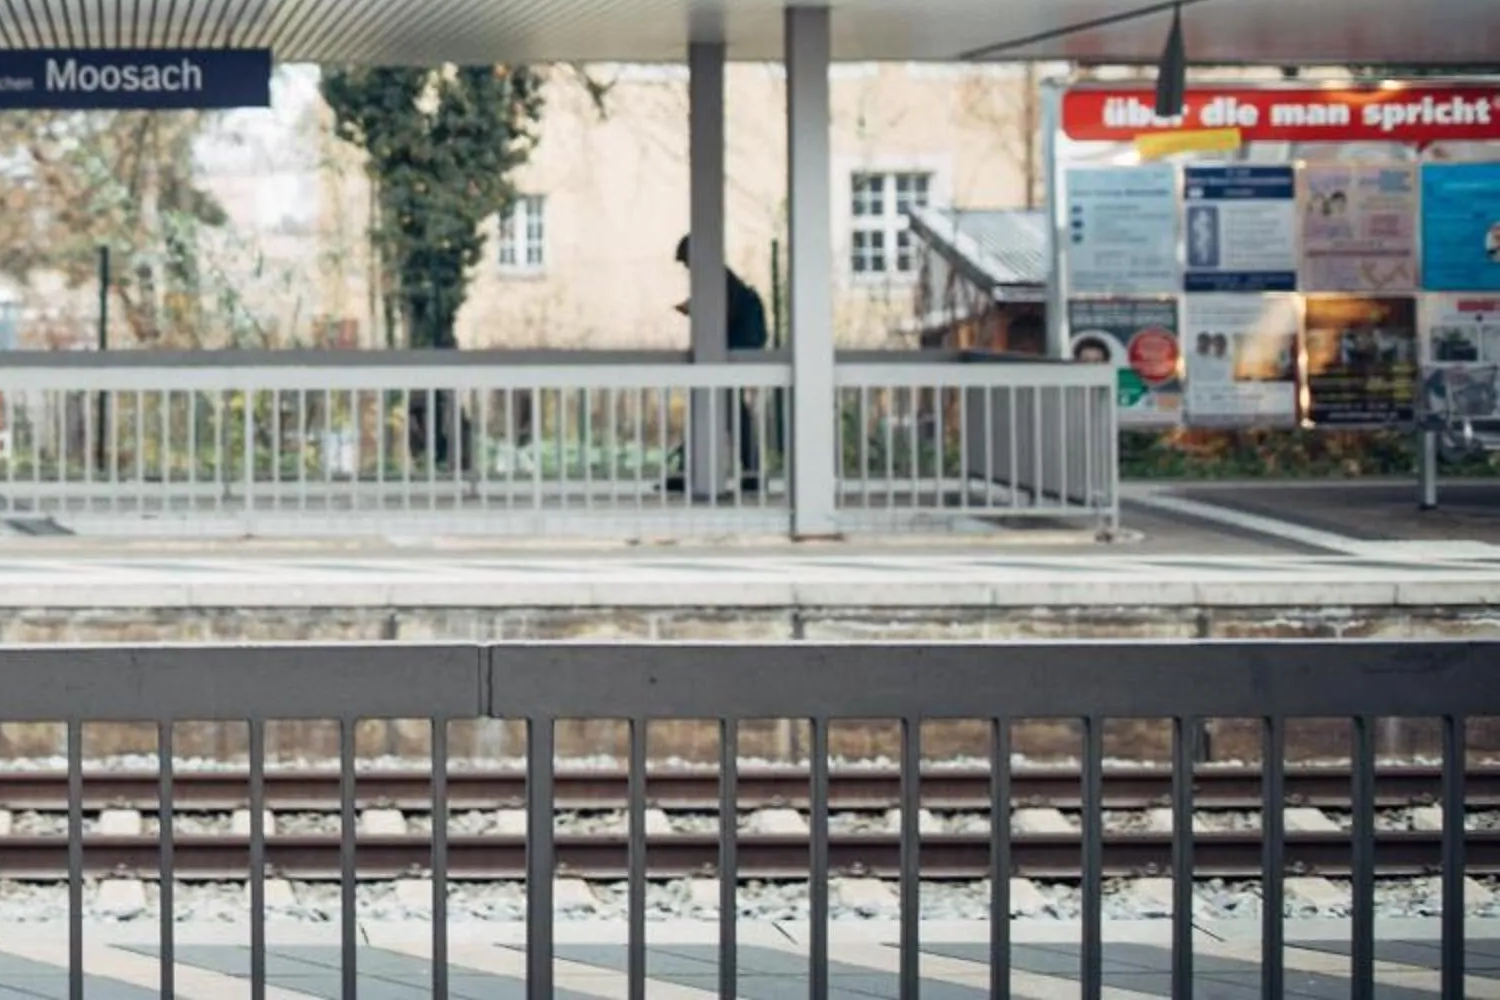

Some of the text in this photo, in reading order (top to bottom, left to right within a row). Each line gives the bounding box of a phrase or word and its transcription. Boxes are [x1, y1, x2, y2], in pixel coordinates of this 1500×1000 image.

[45, 58, 203, 92] Moosach
[1200, 96, 1259, 127] die
[1270, 104, 1350, 126] man
